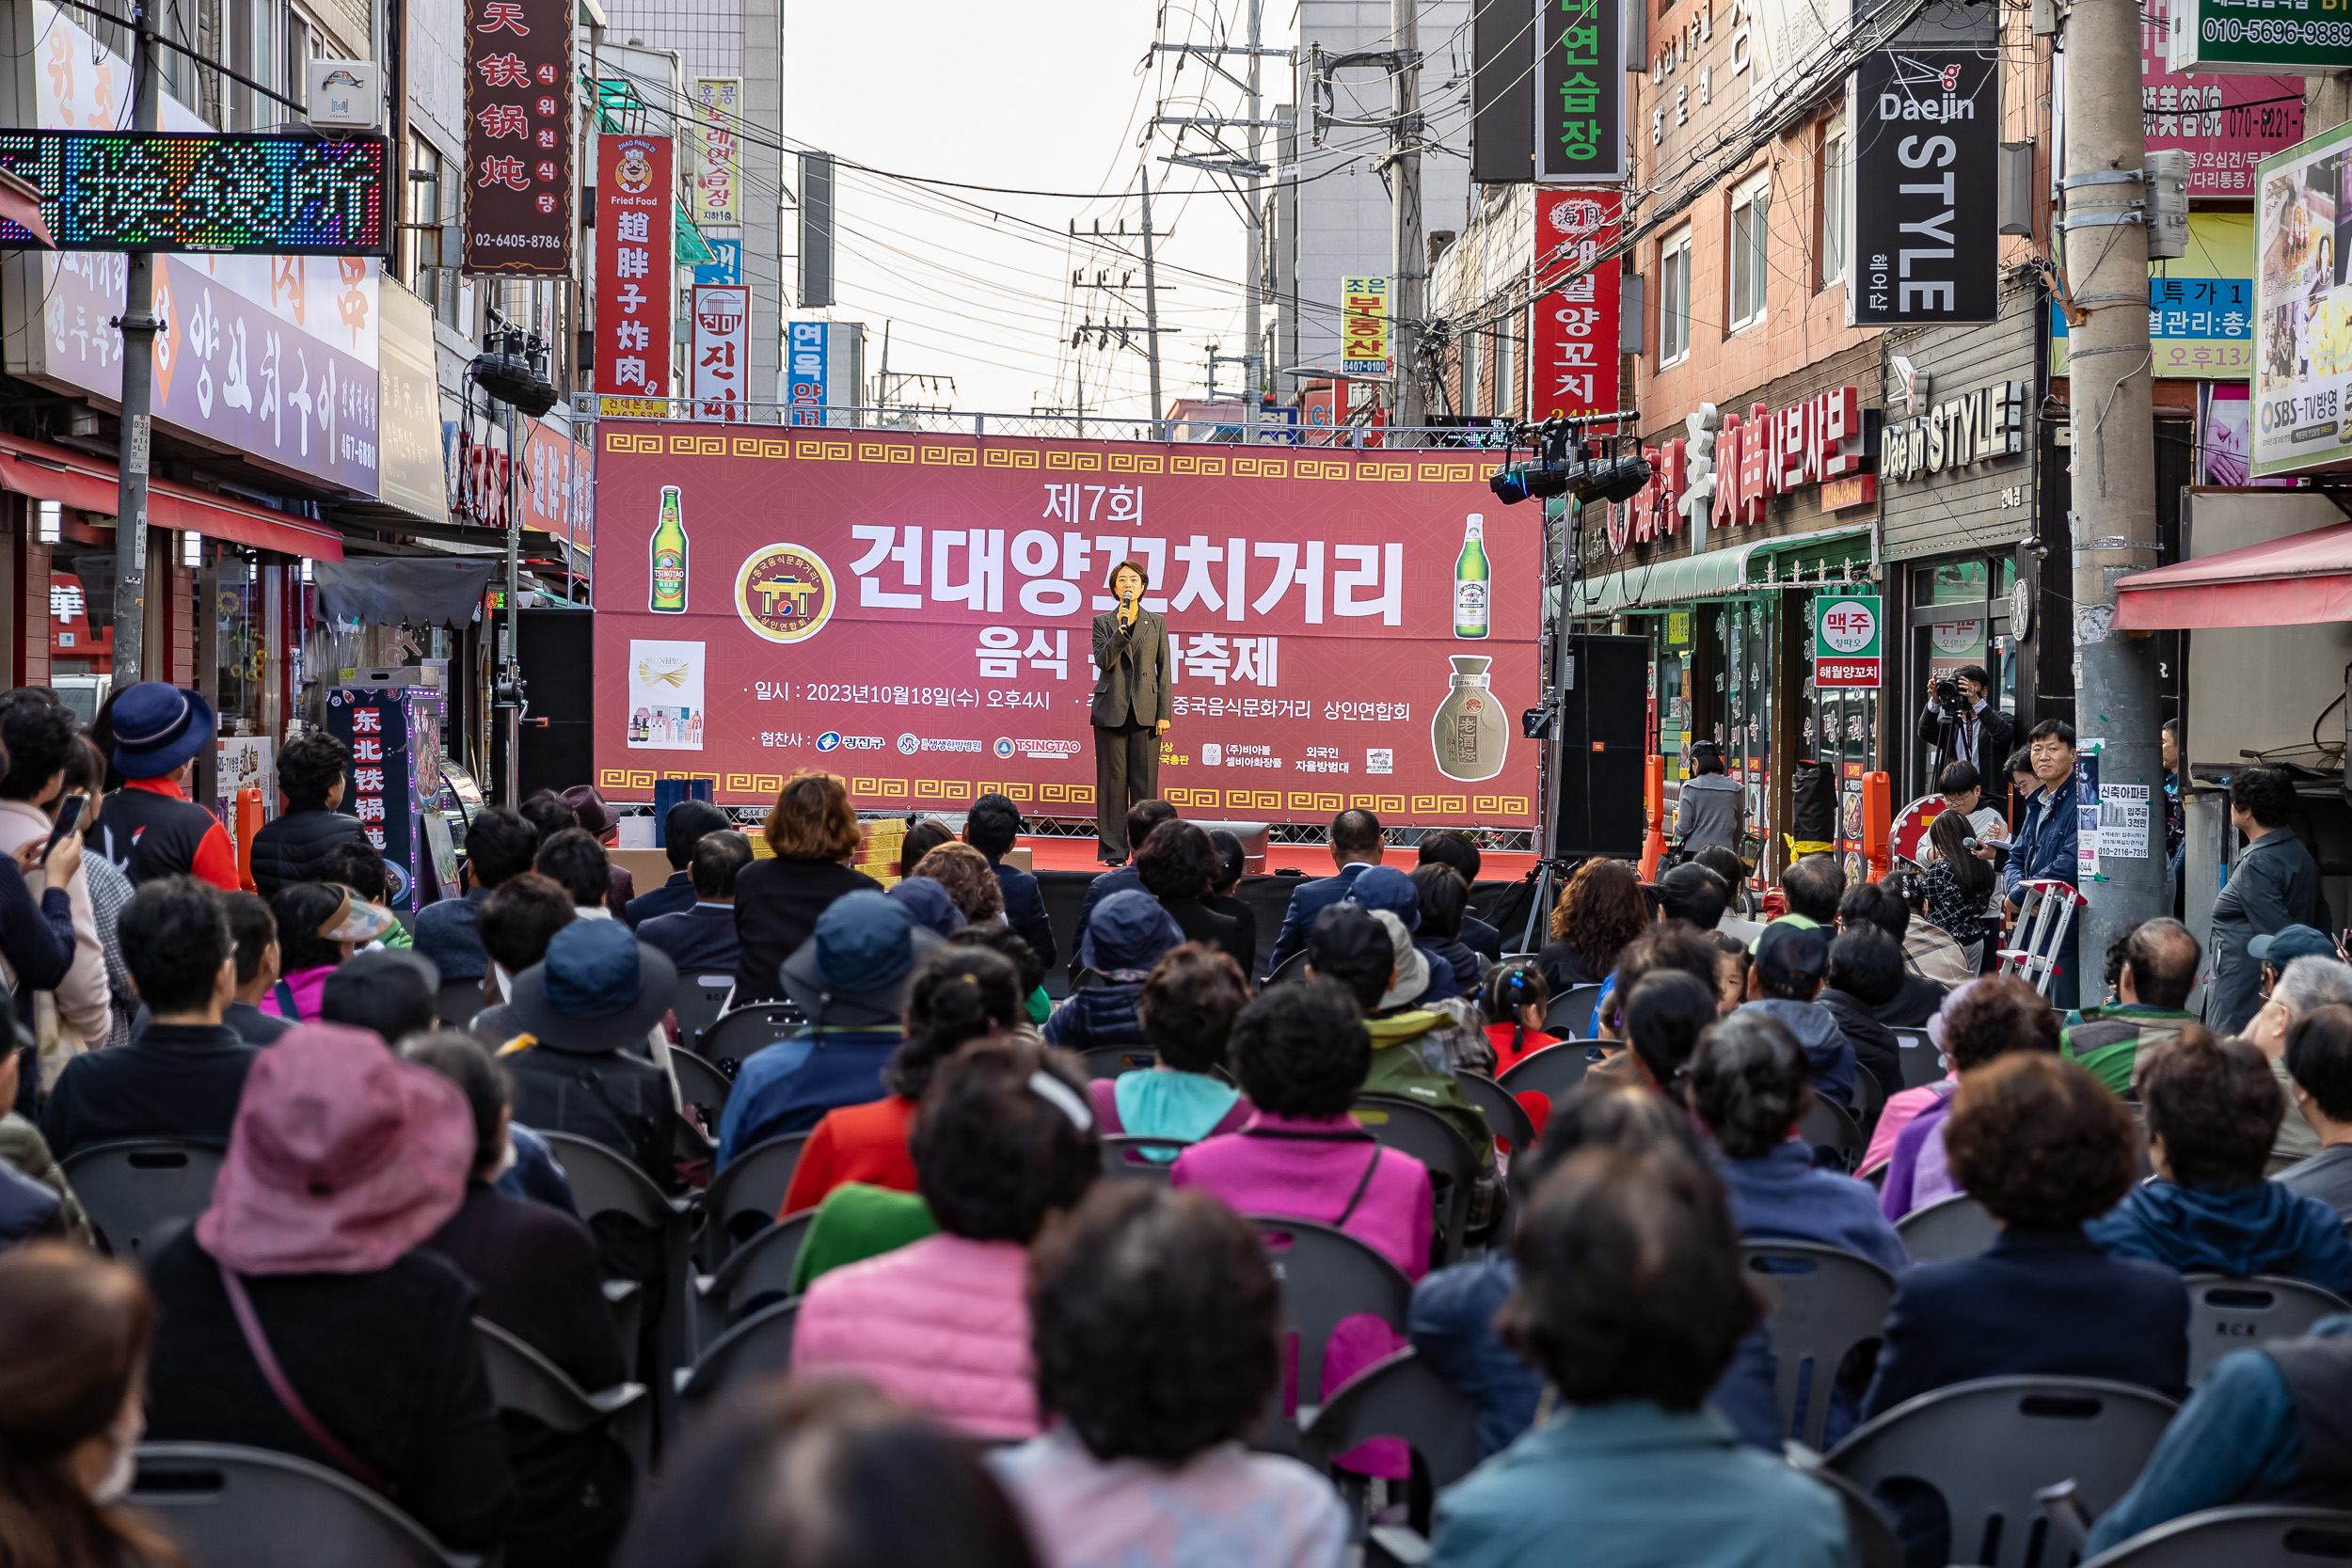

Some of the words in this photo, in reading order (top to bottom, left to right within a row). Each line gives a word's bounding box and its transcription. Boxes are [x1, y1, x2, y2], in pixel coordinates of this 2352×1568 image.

[2202, 17, 2352, 47] 010-5696-9889
[477, 2, 531, 191] 天铁锅炖
[699, 84, 737, 105] 홍콩
[1881, 92, 1975, 124] Daejin
[539, 65, 556, 214] 식위천식당
[617, 139, 633, 151] ZHAO
[634, 139, 650, 150] PANG
[648, 145, 658, 154] ZI
[705, 106, 732, 208] 노래연습장
[611, 196, 634, 205] Fried
[635, 197, 658, 206] Food
[703, 210, 732, 222] 지하1층
[1898, 135, 1957, 313] STYLE
[475, 233, 561, 248] 02-6405-8786
[1346, 278, 1386, 294] 조은
[1868, 253, 1888, 311] 헤어샵
[615, 211, 650, 388] 趙胖子炸肉
[703, 314, 739, 332] 진미
[1347, 296, 1384, 357] 부동산
[1343, 360, 1386, 372] 6407-0100
[189, 287, 337, 466] 양꼬치구이
[1880, 418, 1926, 482] Daejin
[1929, 380, 2010, 473] STYLE
[342, 433, 375, 470] 467-6880
[1041, 483, 1144, 527] 제7회
[2001, 485, 2021, 509] 건대점
[654, 569, 685, 578] TSINGTAO
[753, 555, 819, 581] 중국음식문화거리
[849, 524, 1404, 626] 건대양꼬치거리
[1827, 612, 1870, 635] 맥주
[1835, 638, 1862, 648] 칭따오
[645, 656, 684, 666] SHINHWA
[975, 626, 1069, 680] 음식
[1171, 633, 1279, 688] 축제
[1819, 666, 1878, 680] 해월양꼬치
[755, 680, 789, 702] 일시
[806, 683, 980, 708] 2023년10월18일(수)
[986, 689, 1051, 711] 오후4시
[1171, 695, 1311, 720] 중국음식문화거리
[1323, 701, 1411, 723] 상인연합회
[760, 730, 803, 749] 협찬사
[842, 736, 886, 751] 광진구
[929, 738, 982, 753] 생생한방병원
[1015, 738, 1081, 754] TSINGTAO
[1158, 754, 1190, 767] 국총판
[1306, 747, 1340, 760] 외국인
[1295, 760, 1350, 774] 자율방범대
[2101, 785, 2149, 800] 신축아파트
[2127, 807, 2148, 817] 입주금
[2127, 817, 2148, 828] 3천만
[2098, 847, 2148, 857] 010-2116-7315
